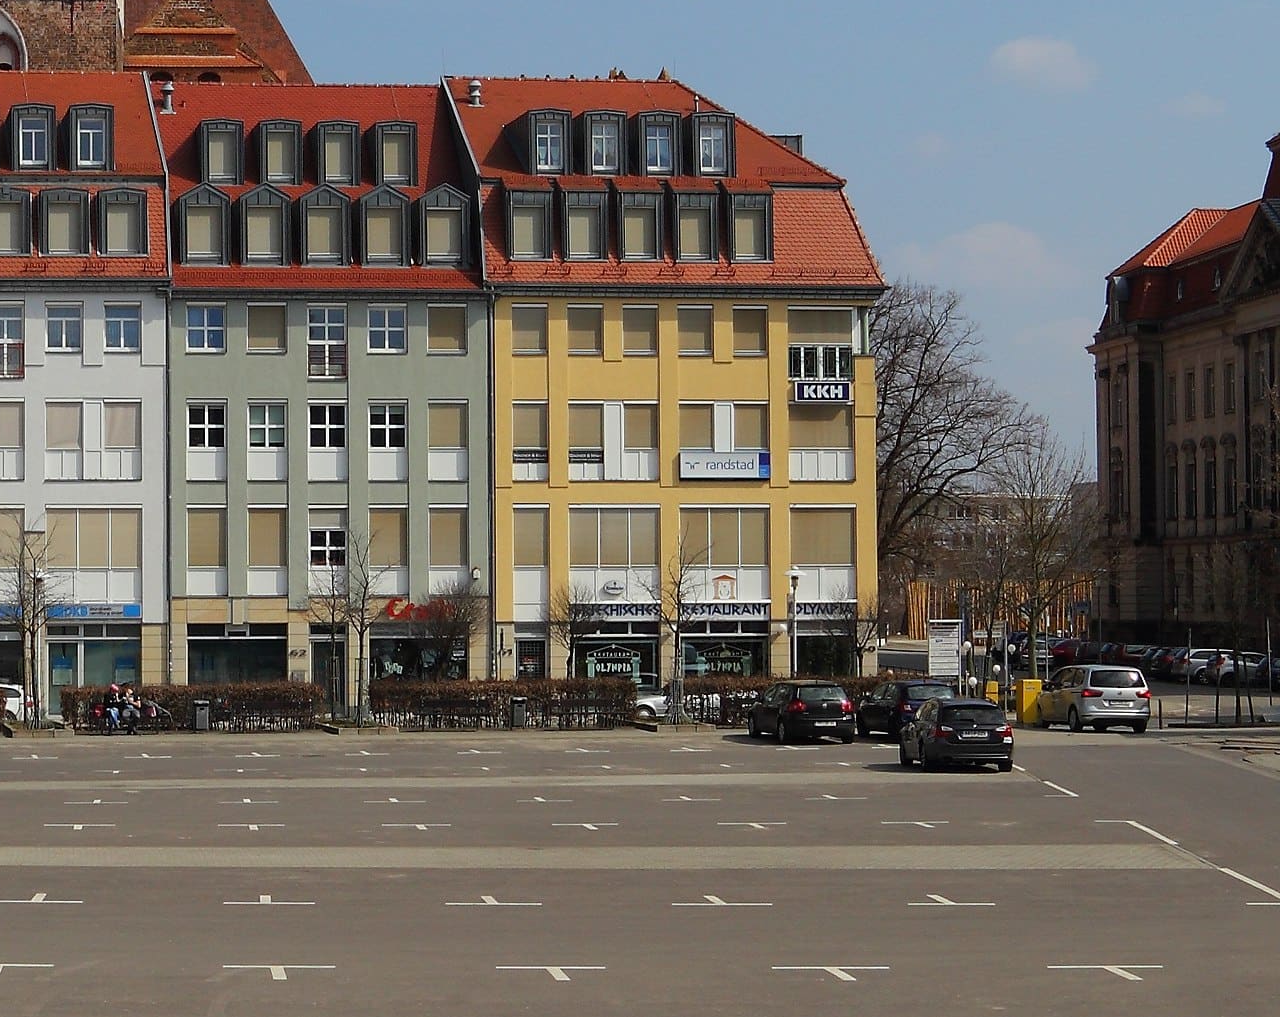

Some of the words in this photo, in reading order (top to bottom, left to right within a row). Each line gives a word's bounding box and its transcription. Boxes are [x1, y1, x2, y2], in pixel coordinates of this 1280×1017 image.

[803, 385, 843, 399] KKH
[705, 459, 754, 470] randstad
[575, 604, 660, 616] IECHISCHES
[680, 604, 768, 616] RESTAURANT
[288, 649, 307, 657] 62
[595, 662, 632, 672] OLYMPIA
